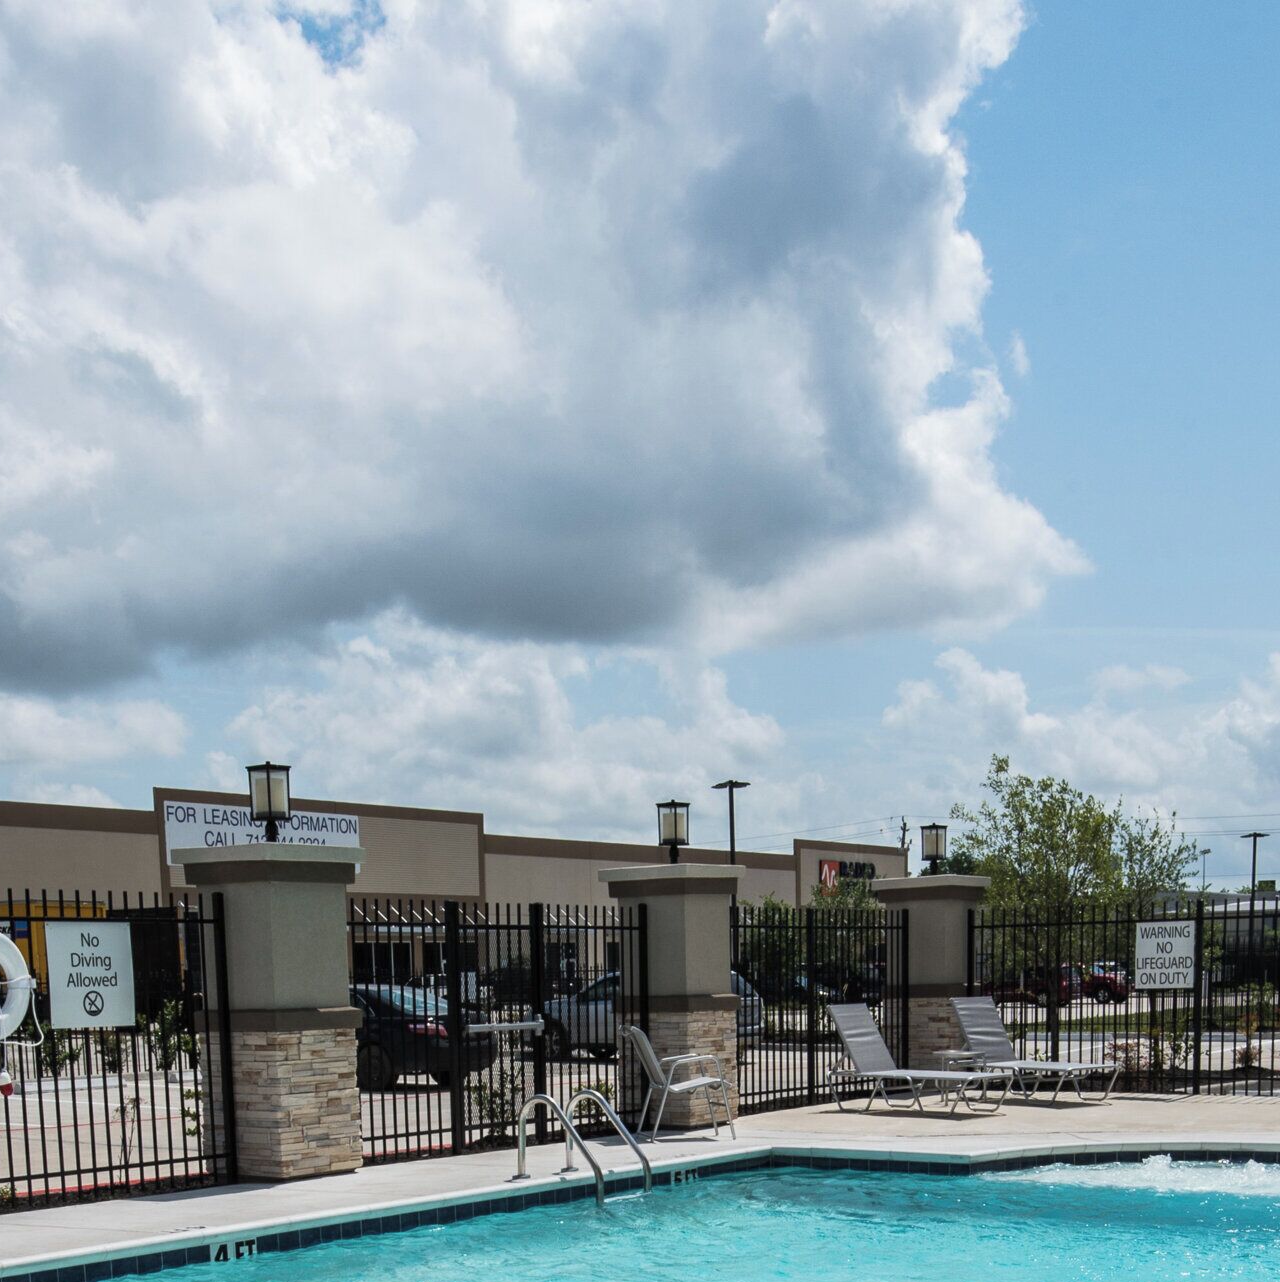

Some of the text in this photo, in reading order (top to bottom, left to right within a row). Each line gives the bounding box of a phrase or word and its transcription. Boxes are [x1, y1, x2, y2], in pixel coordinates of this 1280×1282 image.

[166, 805, 197, 824] FOR
[80, 932, 100, 948] No
[1140, 925, 1191, 940] WARNING
[1156, 941, 1173, 954] NO
[70, 952, 112, 971] Diving
[1136, 956, 1193, 970] LIFEGUARD
[66, 972, 118, 988] Allowed
[1140, 971, 1189, 985] ON DUTY
[214, 1239, 256, 1262] 4 FT
